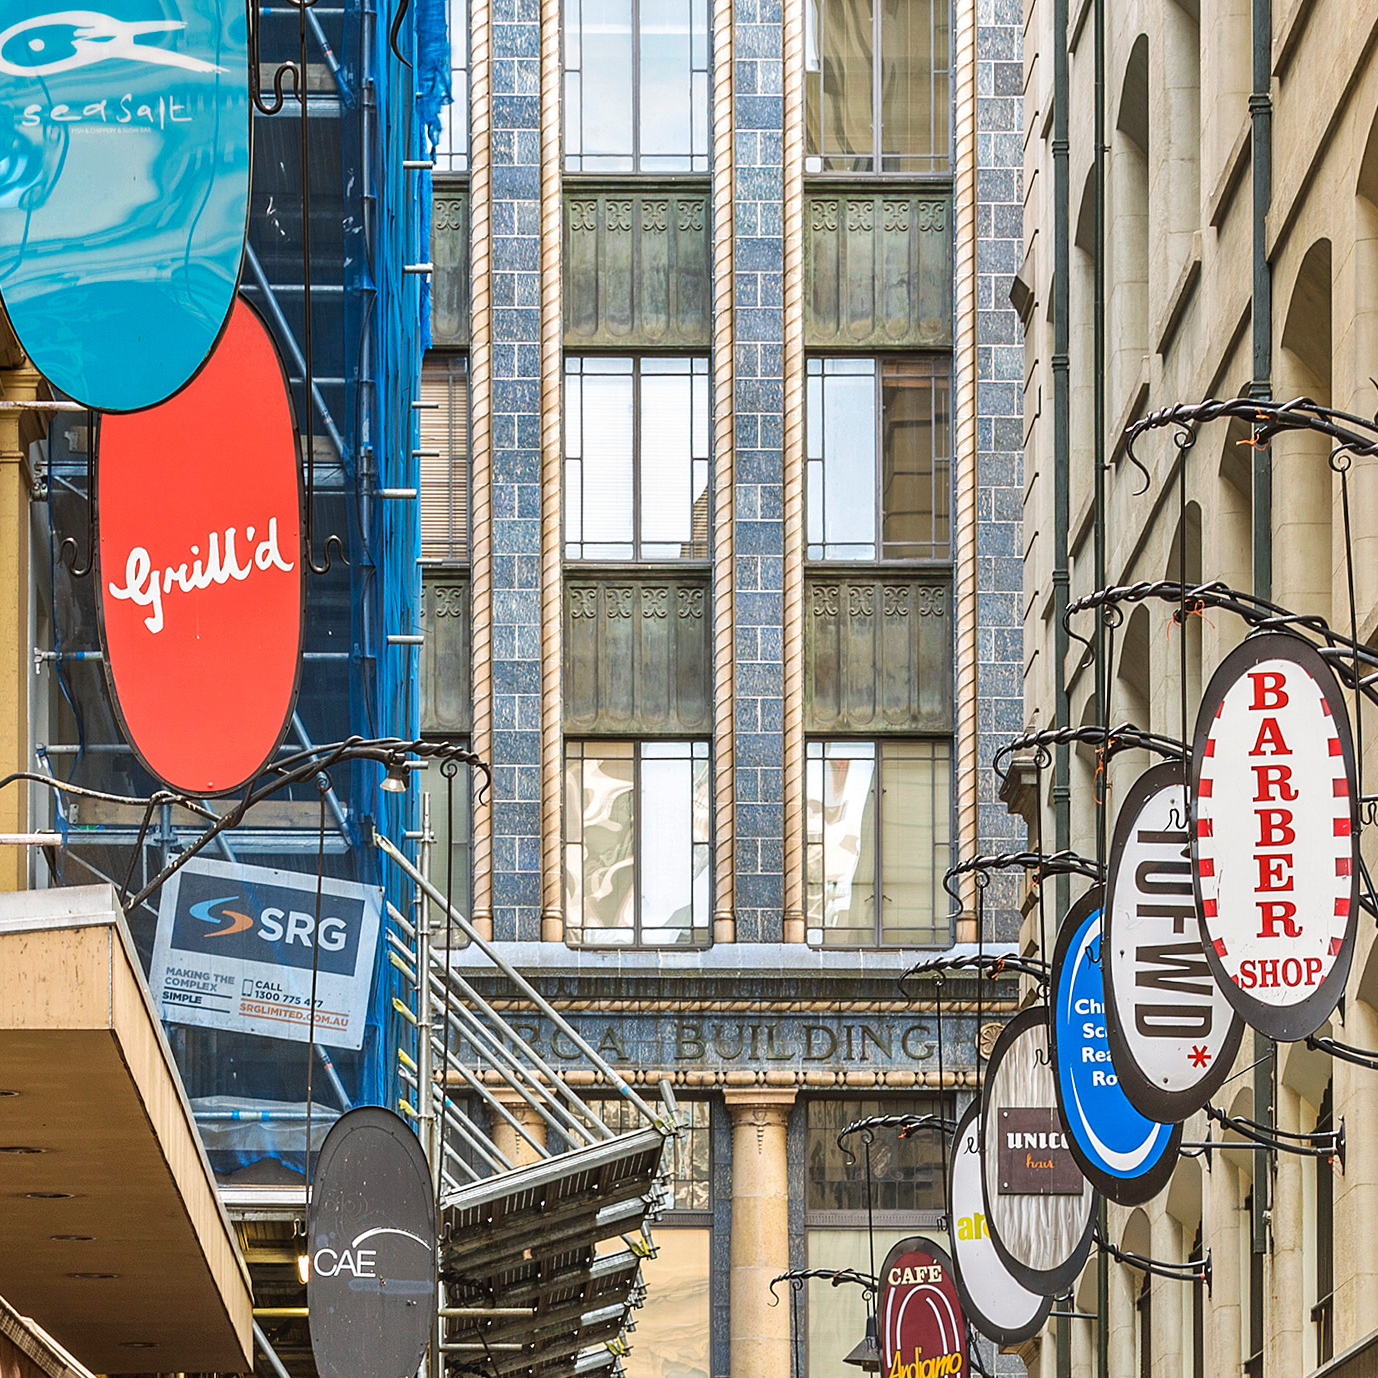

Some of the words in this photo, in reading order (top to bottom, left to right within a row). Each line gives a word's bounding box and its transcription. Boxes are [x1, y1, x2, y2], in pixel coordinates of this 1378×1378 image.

[110, 517, 295, 634] Grill'd
[1247, 671, 1303, 938] BARBER
[259, 906, 349, 953] SRG
[164, 976, 218, 993] COMPLEX
[165, 966, 210, 982] MAKING
[213, 973, 235, 985] THE
[255, 980, 283, 993] CALL
[1239, 957, 1323, 989] SHOP
[162, 991, 203, 1005] SIMPLE
[254, 990, 280, 1001] 1300
[282, 994, 302, 1005] 775
[239, 1002, 349, 1028] SRGLIMITED.COM.AU
[674, 1023, 936, 1061] BUILDING
[1083, 1023, 1108, 1038] Sc
[312, 1248, 377, 1278] CAE
[887, 1258, 943, 1286] CAFÉ
